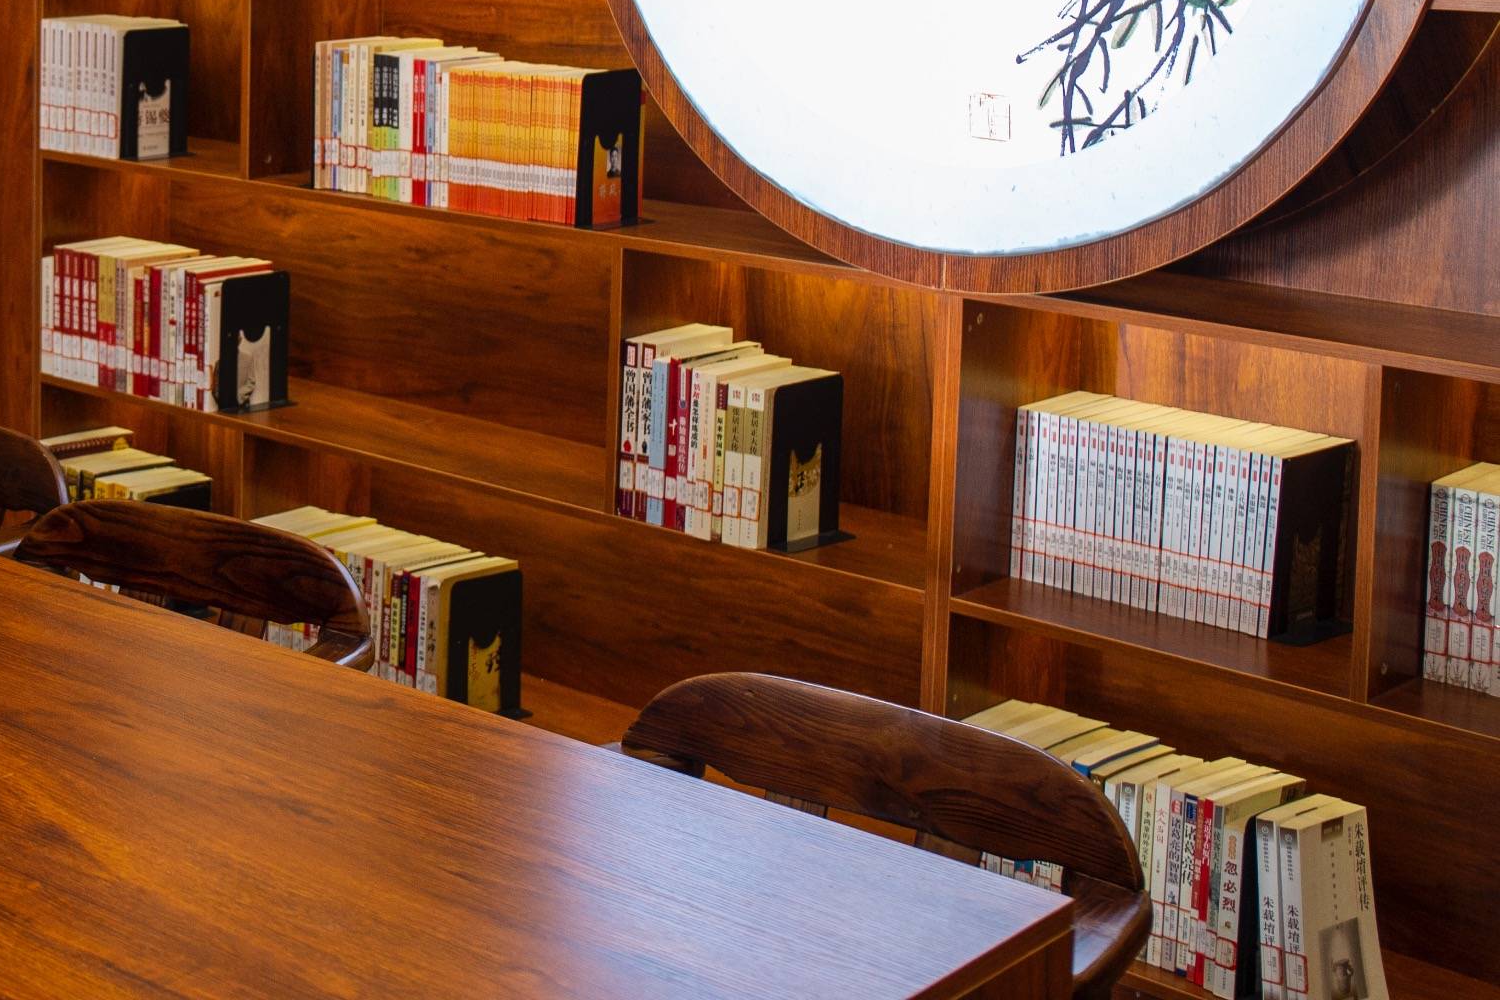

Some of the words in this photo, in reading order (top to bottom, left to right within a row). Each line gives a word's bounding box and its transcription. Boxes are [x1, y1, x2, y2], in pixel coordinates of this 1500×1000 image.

[1463, 506, 1473, 546] CHINESE
[1486, 510, 1496, 552] CHINESE
[1222, 860, 1239, 914] 忽必烈
